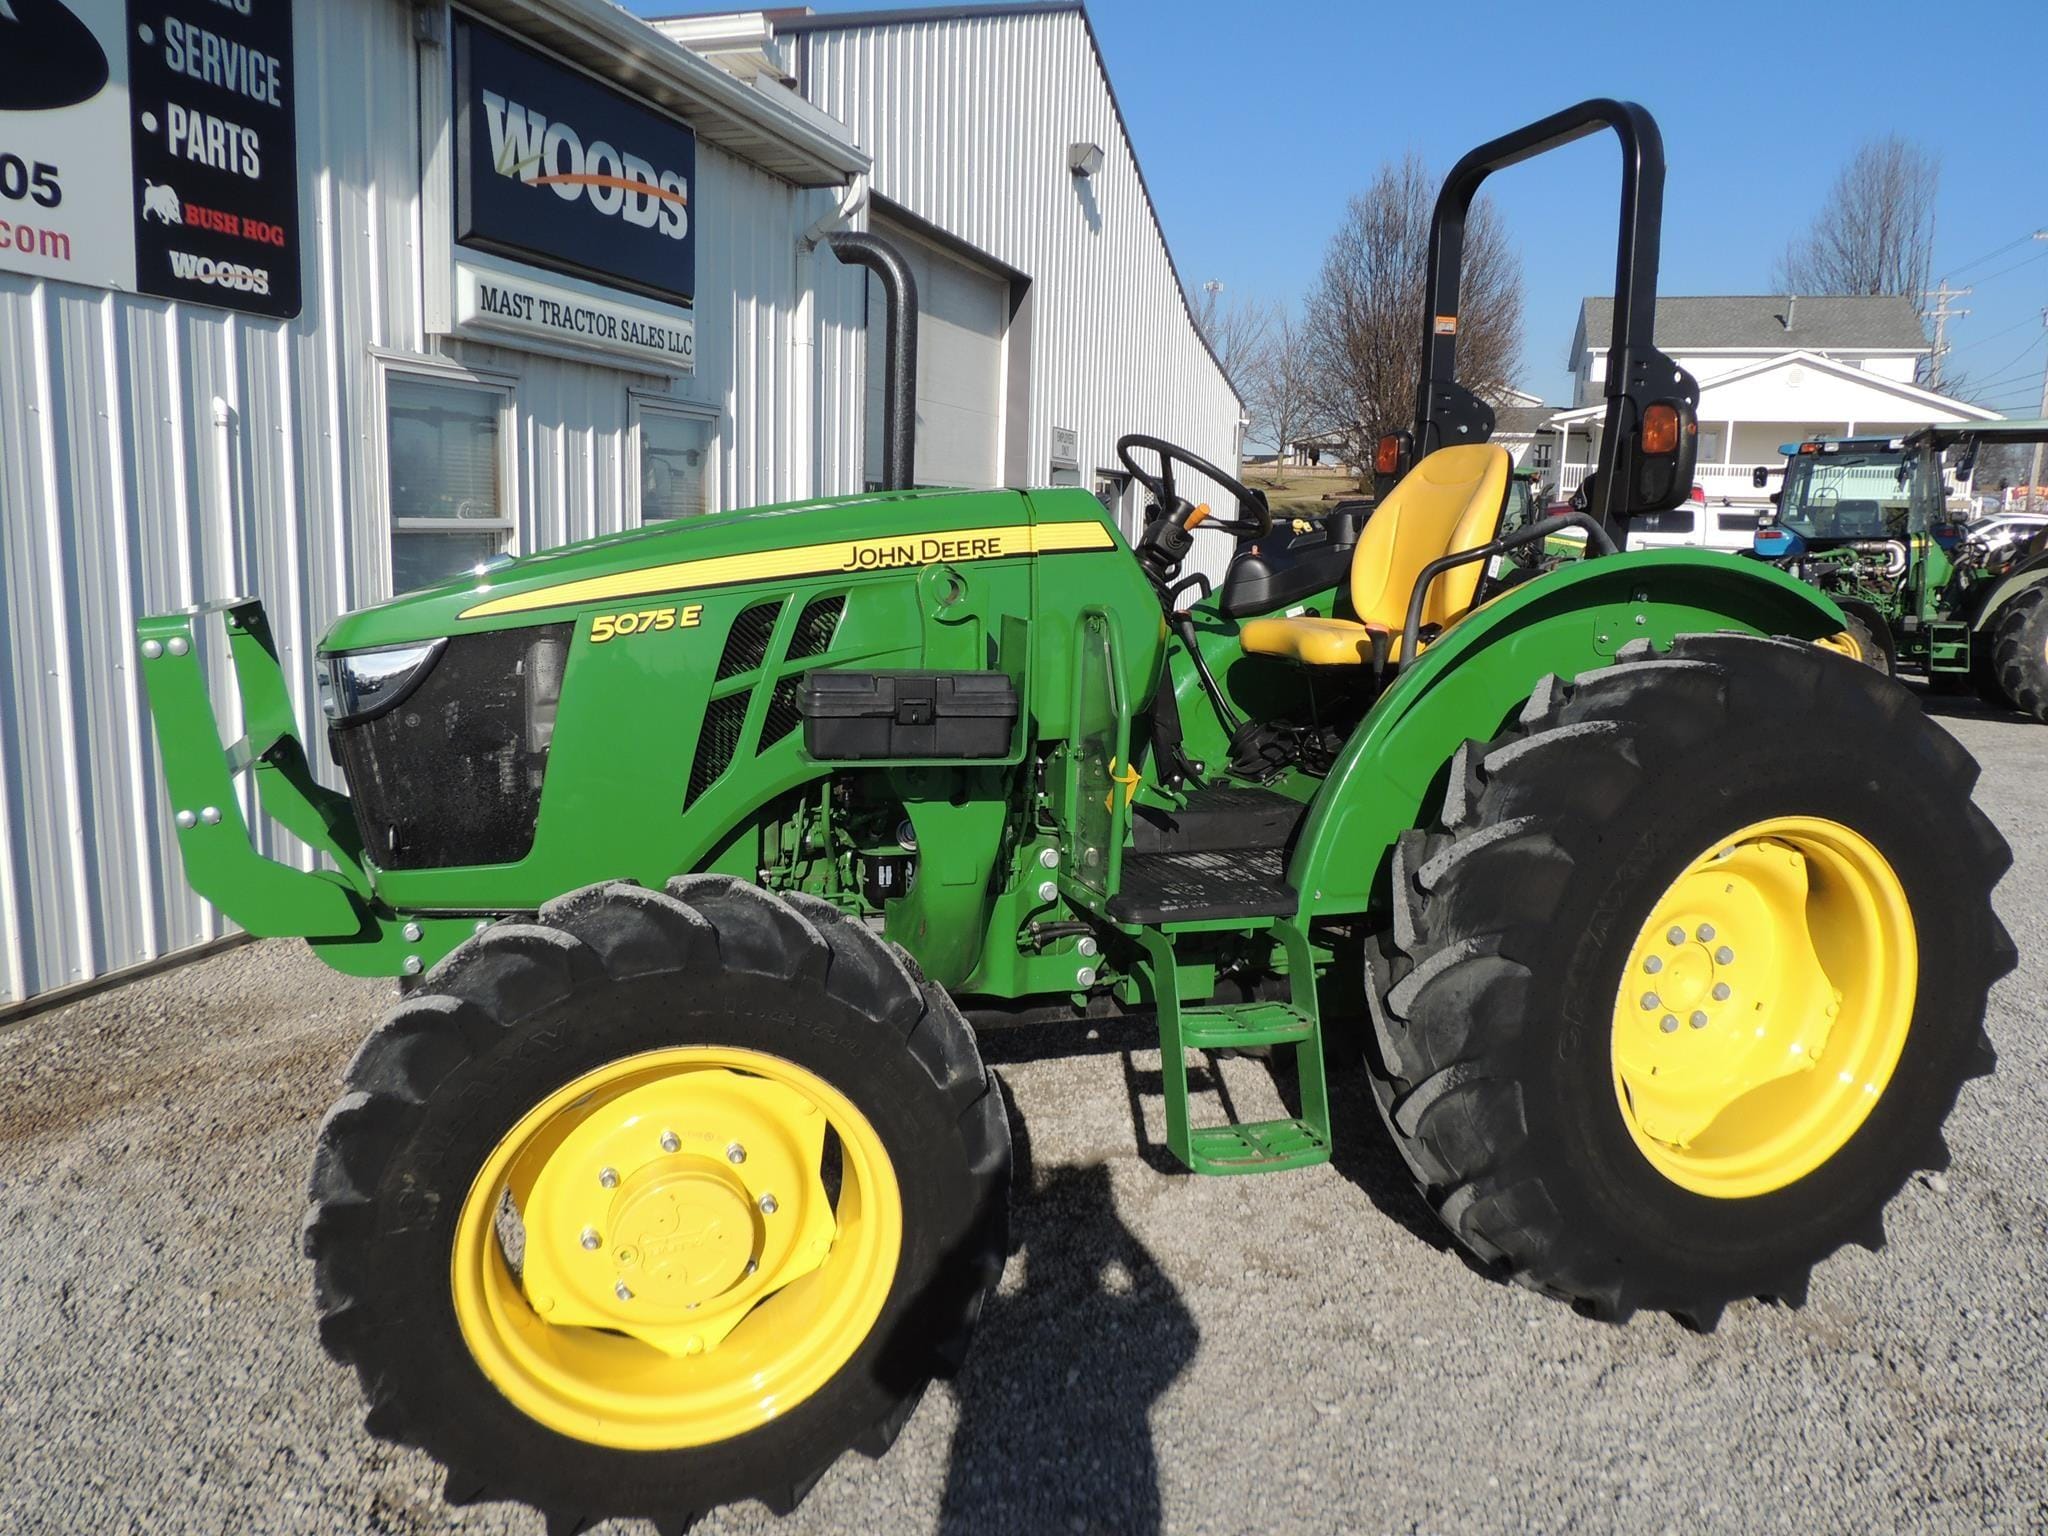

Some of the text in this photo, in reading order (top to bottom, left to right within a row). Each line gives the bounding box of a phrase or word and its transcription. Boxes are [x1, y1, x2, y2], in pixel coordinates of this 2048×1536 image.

[164, 16, 281, 108] SERVICE
[167, 101, 260, 179] PARTS
[482, 88, 688, 240] WOODS
[184, 203, 285, 248] BUSH HOG
[168, 250, 270, 296] WOODS
[480, 284, 692, 356] MAST TRACTOR SALES LLC
[843, 537, 1002, 568] JOHN DEERE
